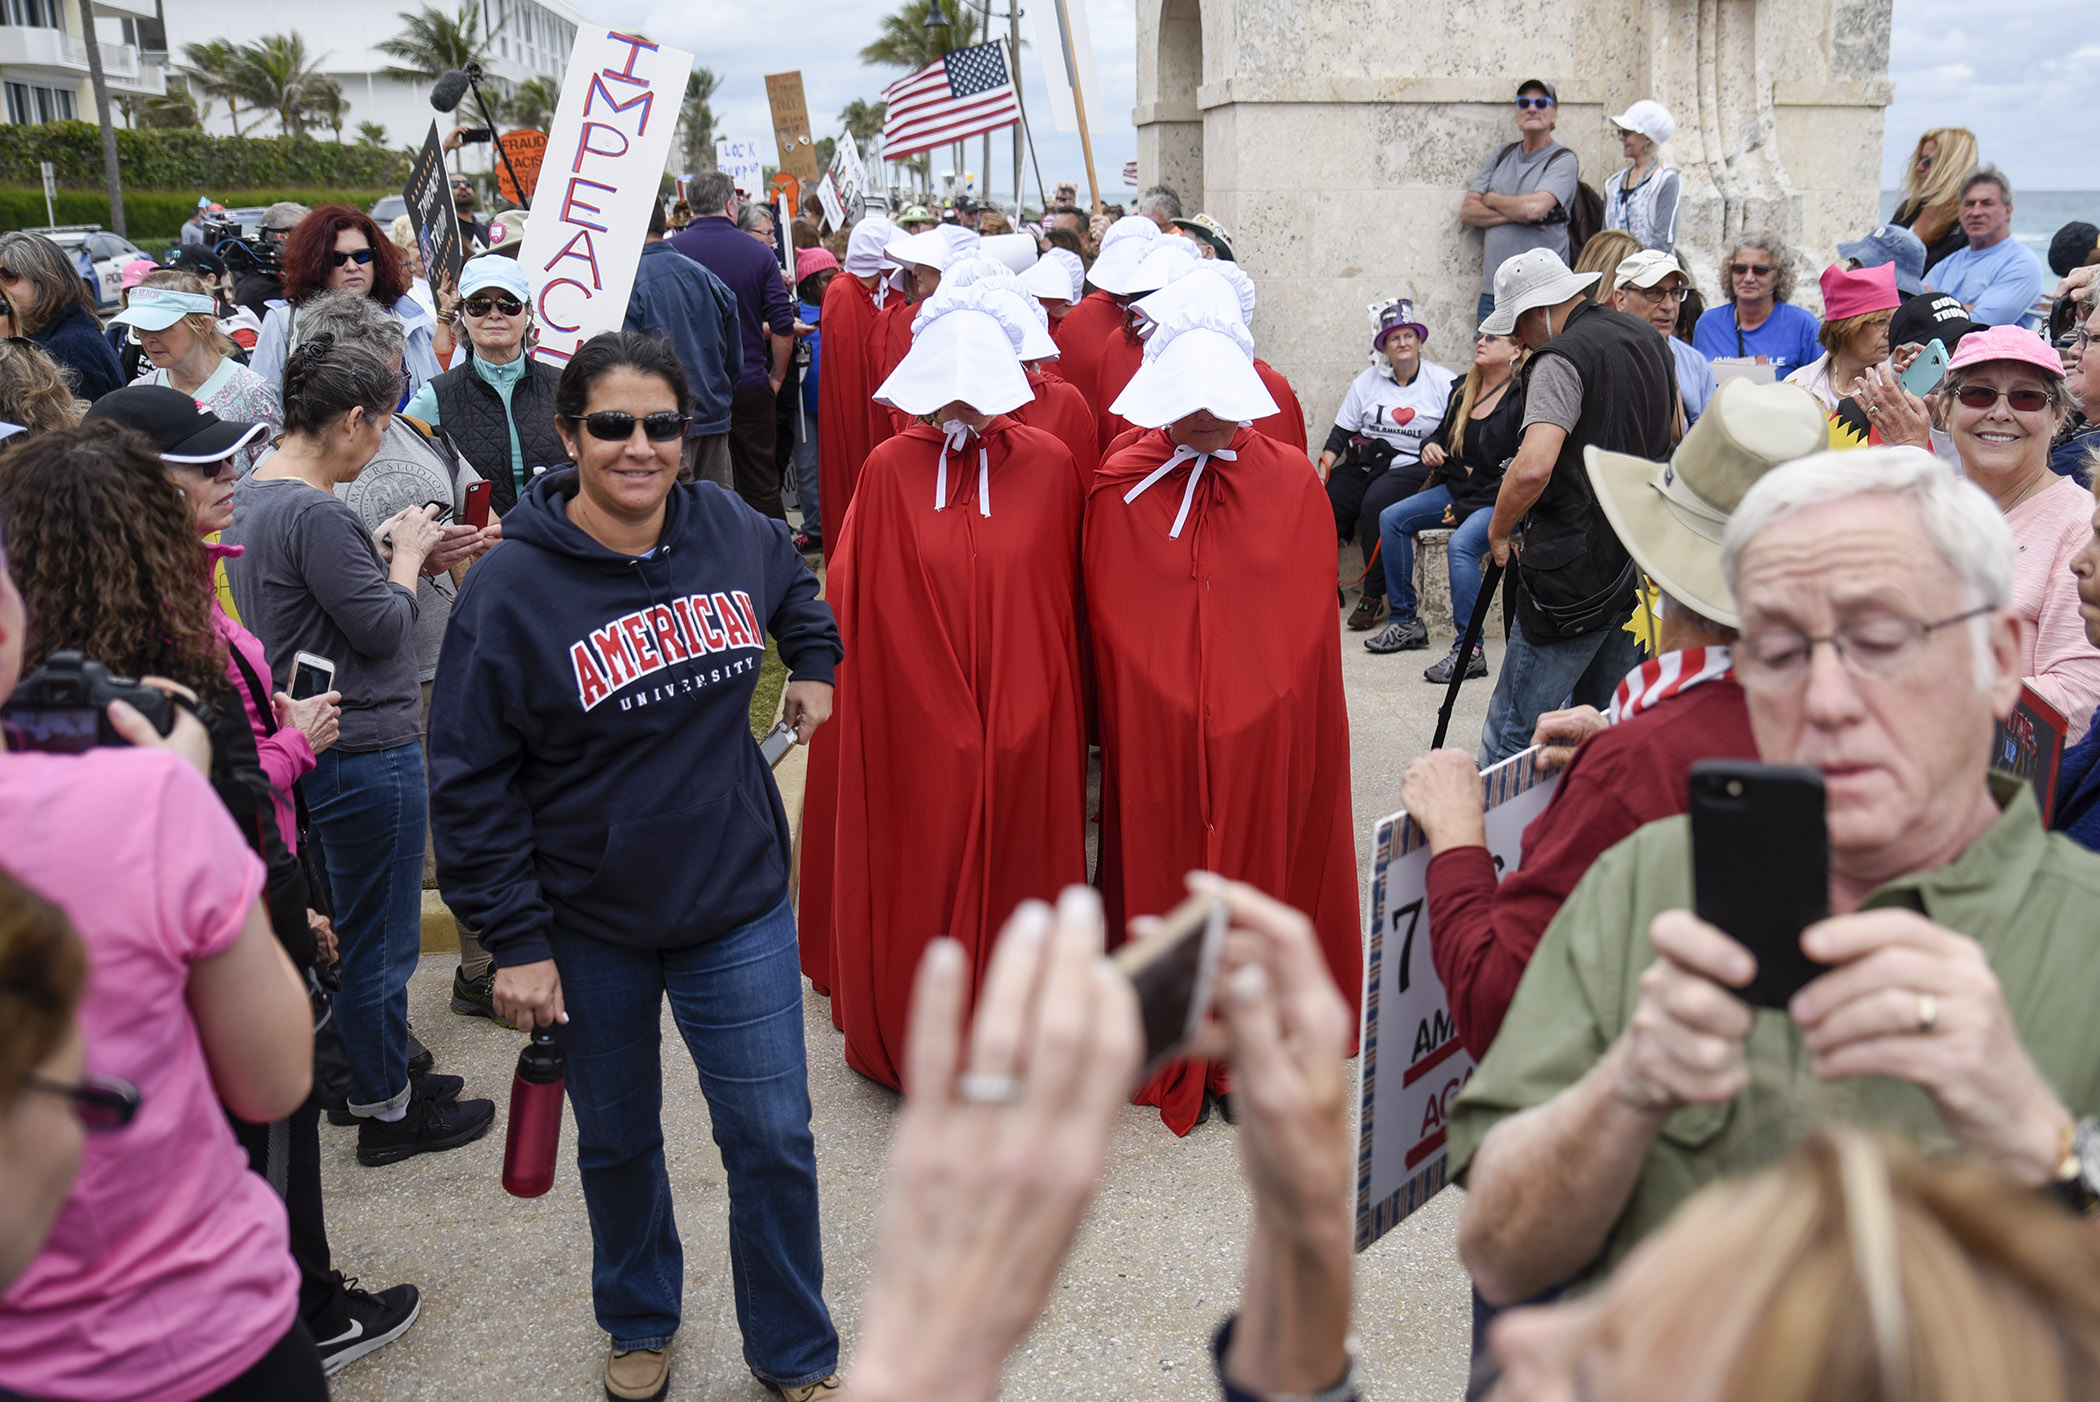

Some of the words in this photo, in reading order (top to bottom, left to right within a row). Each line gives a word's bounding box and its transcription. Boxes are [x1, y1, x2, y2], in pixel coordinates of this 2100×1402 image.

[501, 134, 547, 150] FRAUD
[724, 142, 756, 158] LOCK
[417, 161, 441, 226] IMPEACH
[1933, 307, 1969, 322] TRUM
[350, 465, 382, 504] MATER
[386, 462, 446, 504] STUDIOR
[570, 590, 766, 713] AMERICAN
[620, 657, 755, 711] UNIVERSITY
[2004, 739, 2018, 764] UP
[1411, 1008, 1456, 1064] AM
